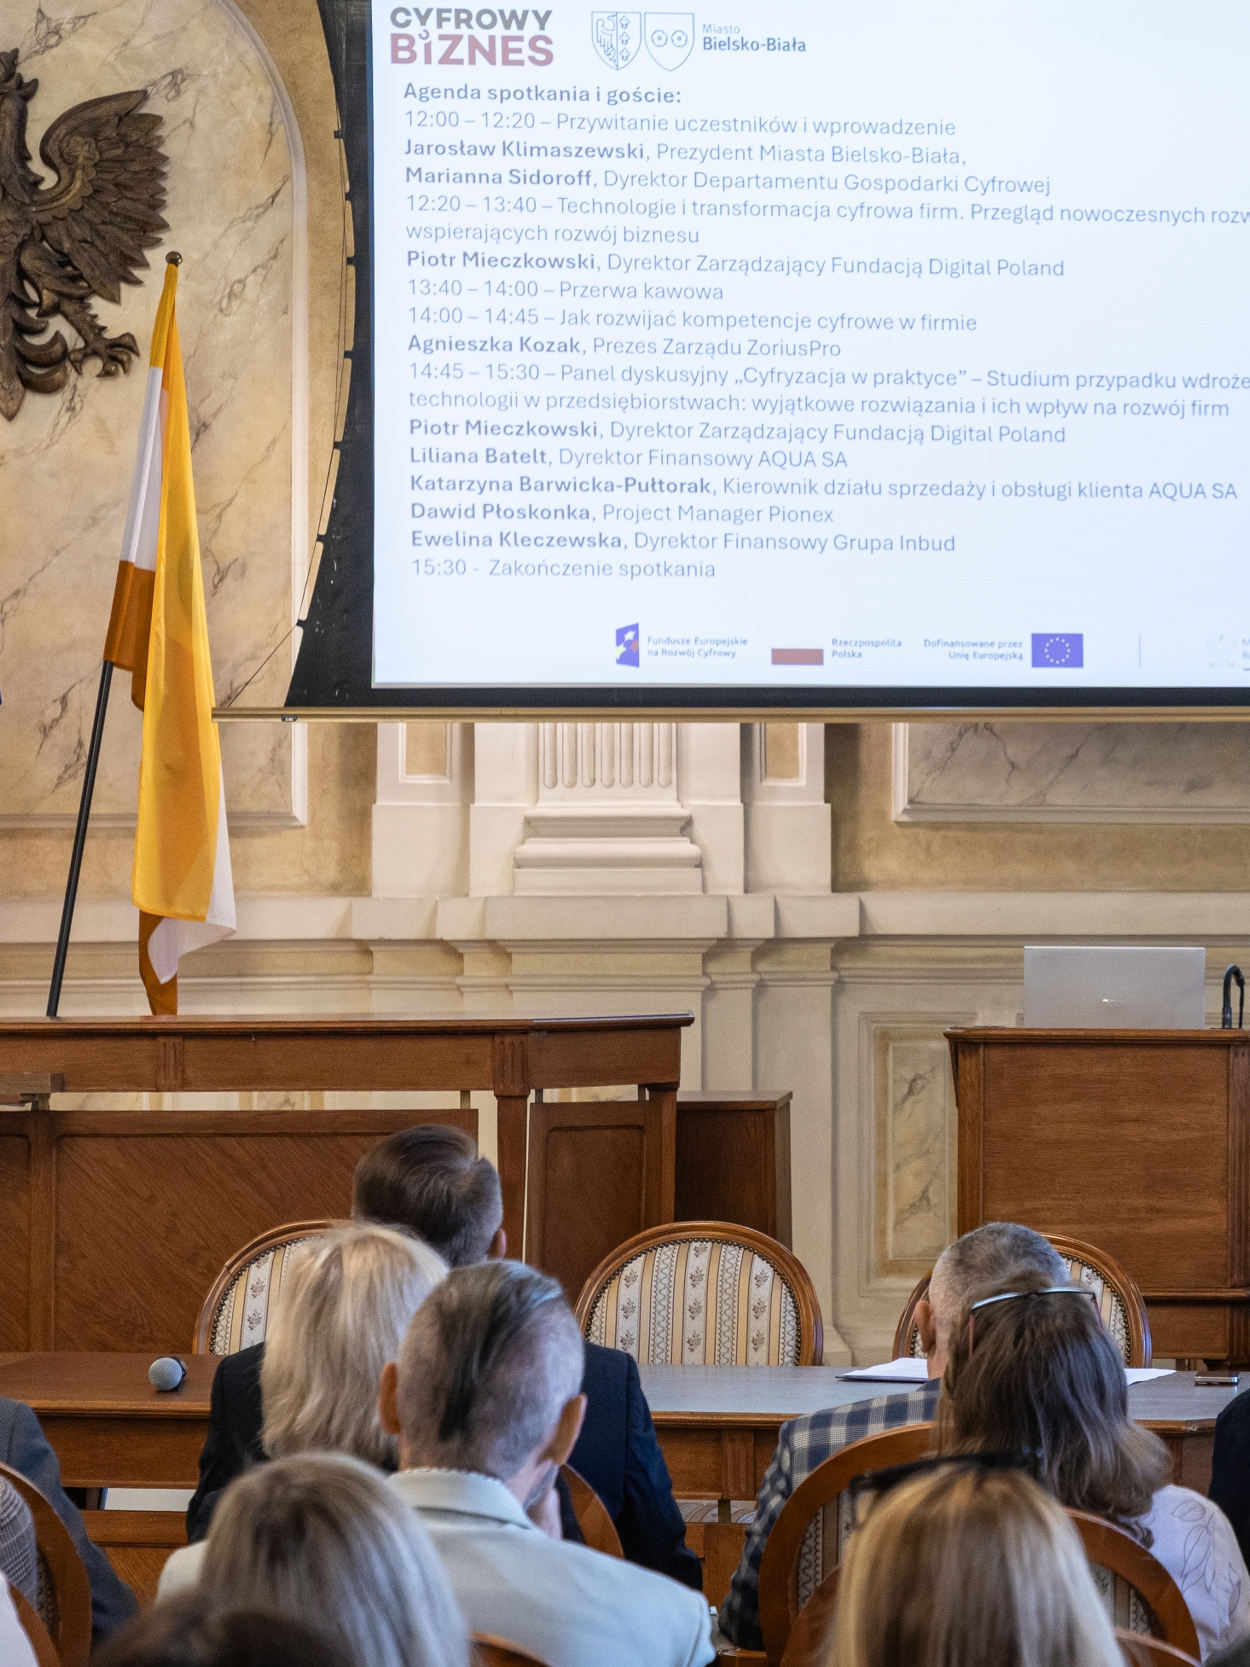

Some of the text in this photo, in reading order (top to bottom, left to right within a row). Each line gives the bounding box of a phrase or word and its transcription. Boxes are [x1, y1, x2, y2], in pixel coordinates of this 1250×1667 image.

[390, 6, 554, 31] CYFROWY
[702, 23, 741, 35] Miasto
[703, 36, 807, 53] Bielsko-Biała
[404, 82, 680, 107] Agenda spotkania i goście:
[406, 109, 459, 128] 12:00
[482, 111, 535, 129] 12:20
[557, 112, 668, 134] Przywitanie
[675, 115, 797, 134] uczestników
[804, 117, 807, 134] i
[813, 118, 956, 138] wprowadzenie
[405, 139, 966, 167] Jarosław Klimaszewski, Prezydent Miasta Bielsko-Biała,
[406, 166, 1050, 197] Marianna Sidoroff, Dyrektor Departamentu Gospodarki Cyfrowej
[406, 194, 461, 212] 12:20
[483, 195, 538, 214] 13:40
[557, 196, 676, 220] Technologie
[682, 199, 686, 216] i
[692, 199, 830, 222] transformacja
[837, 202, 913, 222] cyfrowa
[919, 202, 964, 220] firm.
[971, 202, 1054, 226] Przegląd
[1060, 206, 1205, 227] nowoczesnych
[406, 223, 699, 246] wspierających rozwój biznesu
[407, 249, 1064, 279] Piotr Mieczkowski, Dyrektor Zarządzający Fundacją Digital Poland
[409, 279, 462, 296] 13:40
[485, 279, 538, 298] 14:00
[560, 280, 637, 299] Przerwa
[644, 282, 723, 300] kawowa
[409, 306, 463, 324] 14:00
[485, 308, 539, 325] 14:45
[560, 308, 590, 326] Jak
[596, 309, 676, 330] rozwijać
[683, 310, 811, 333] kompetencje
[817, 312, 894, 334] cyfrowe
[899, 317, 916, 331] w
[921, 314, 977, 331] firmie
[408, 334, 841, 360] Agnieszka Kozak, Prezes Zarządu ZoriusPro
[410, 362, 463, 380] 14:45
[486, 362, 541, 381] 15:30
[561, 363, 615, 382] Panel
[621, 365, 728, 387] dyskusyjny
[851, 372, 868, 385] w
[987, 369, 1069, 387] Studium
[1076, 371, 1176, 392] przypadku
[409, 390, 1229, 420] technologii w przedsiębiorstwach: wyjątkowe rozwiązania i ich wpływ na rozwój firm
[410, 418, 1065, 446] Piotr Mieczkowski, Dyrektor Zarządzający Fundacją Digital Poland
[410, 446, 848, 471] Liliana Batelt, Dyrektor Finansowy AQUA SA
[411, 474, 1237, 502] Katarzyna Barwicka-Pułtorak, Kierownik działu sprzedaży i obsługi klienta AQUA SA
[411, 502, 833, 525] Dawid Płoskonka, Project Manager Pionex
[412, 530, 955, 555] Ewelina Kleczewska, Dyrektor Finansowy Grupa Inbud
[413, 558, 466, 576] 15:30
[489, 558, 612, 577] Zakończenie
[619, 560, 715, 580] spotkania
[647, 636, 748, 649] Fundusze Europejskie
[647, 647, 737, 660] na Rozwój Cyfrowy
[831, 637, 903, 649] Rzeczpospolita
[831, 649, 863, 659] Polska
[923, 637, 1023, 650] Dofinansowane przez
[948, 650, 1024, 662] Unię Europejską
